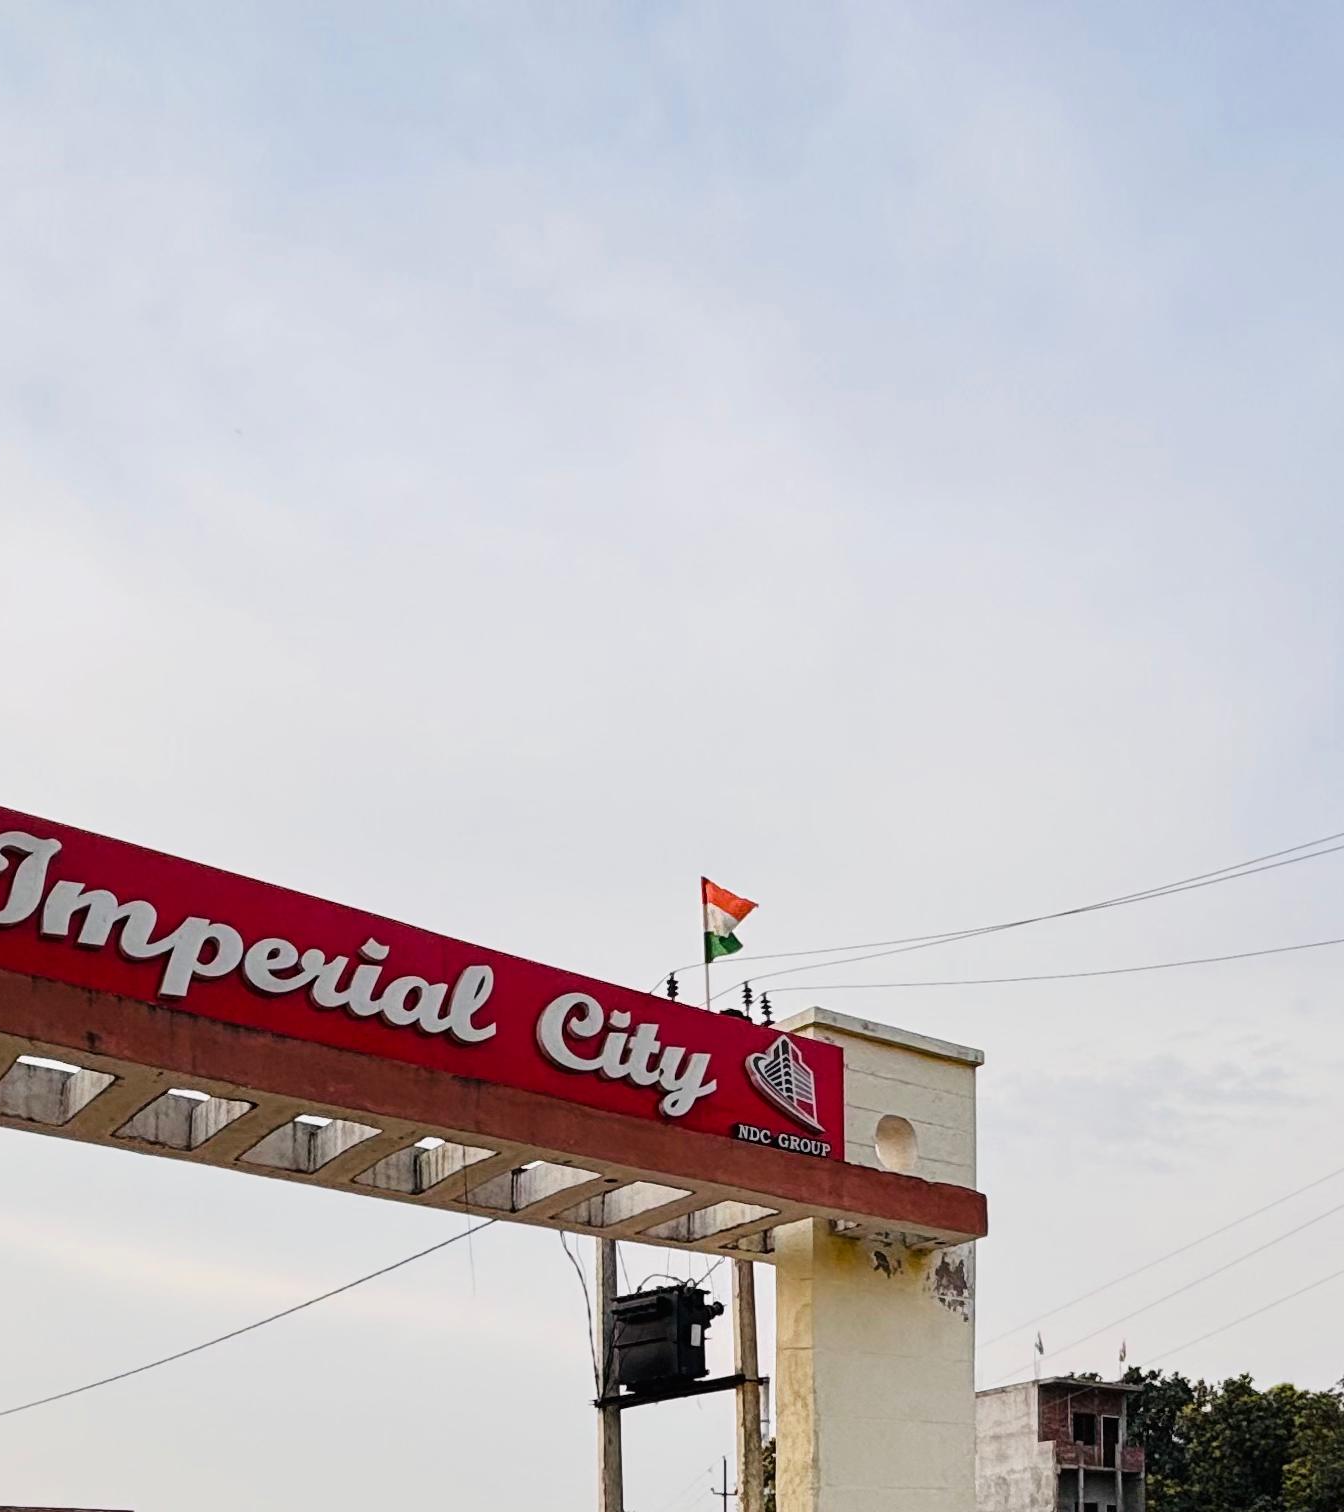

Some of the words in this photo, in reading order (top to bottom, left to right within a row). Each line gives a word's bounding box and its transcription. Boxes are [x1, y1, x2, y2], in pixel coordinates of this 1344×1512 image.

[536, 992, 718, 1117] City
[738, 1124, 771, 1144] NDC
[778, 1133, 831, 1157] GROUP
